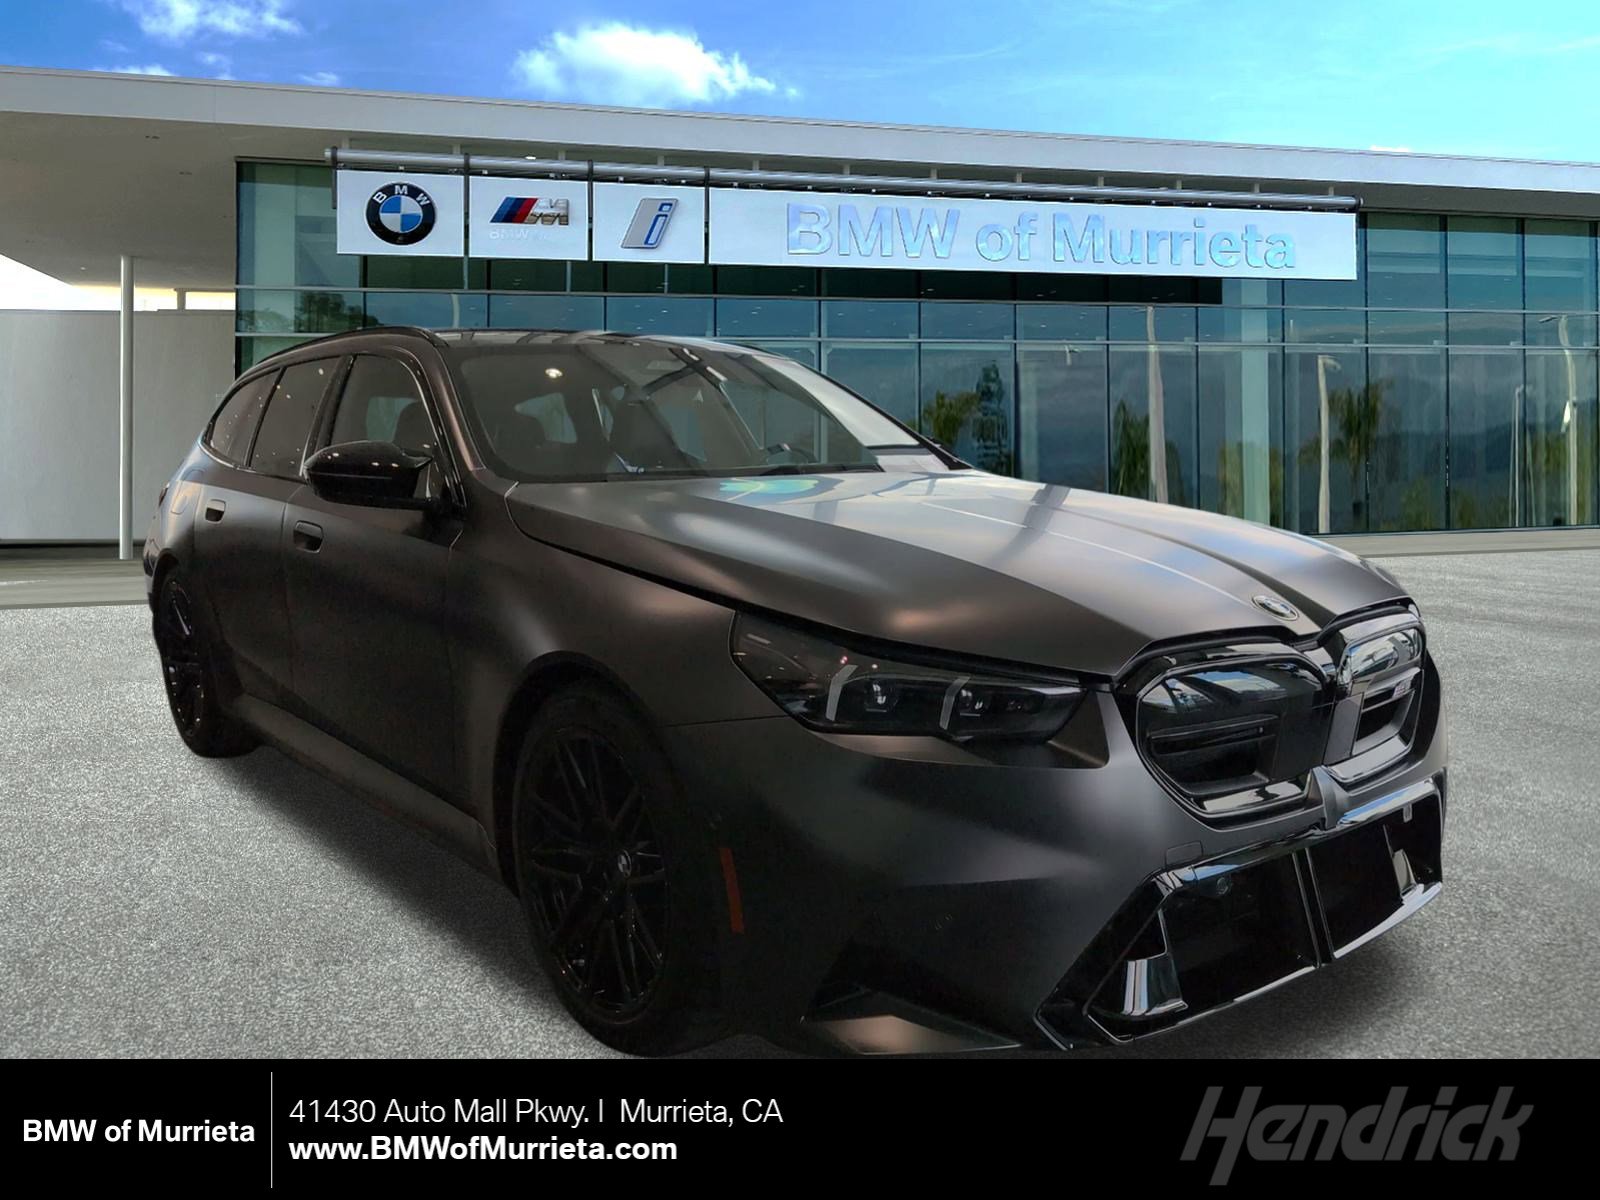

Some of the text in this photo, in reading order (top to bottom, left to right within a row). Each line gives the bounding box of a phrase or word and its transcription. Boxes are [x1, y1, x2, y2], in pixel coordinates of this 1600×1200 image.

[372, 184, 431, 206] BMW
[786, 201, 1296, 270] BMW of Murrieta
